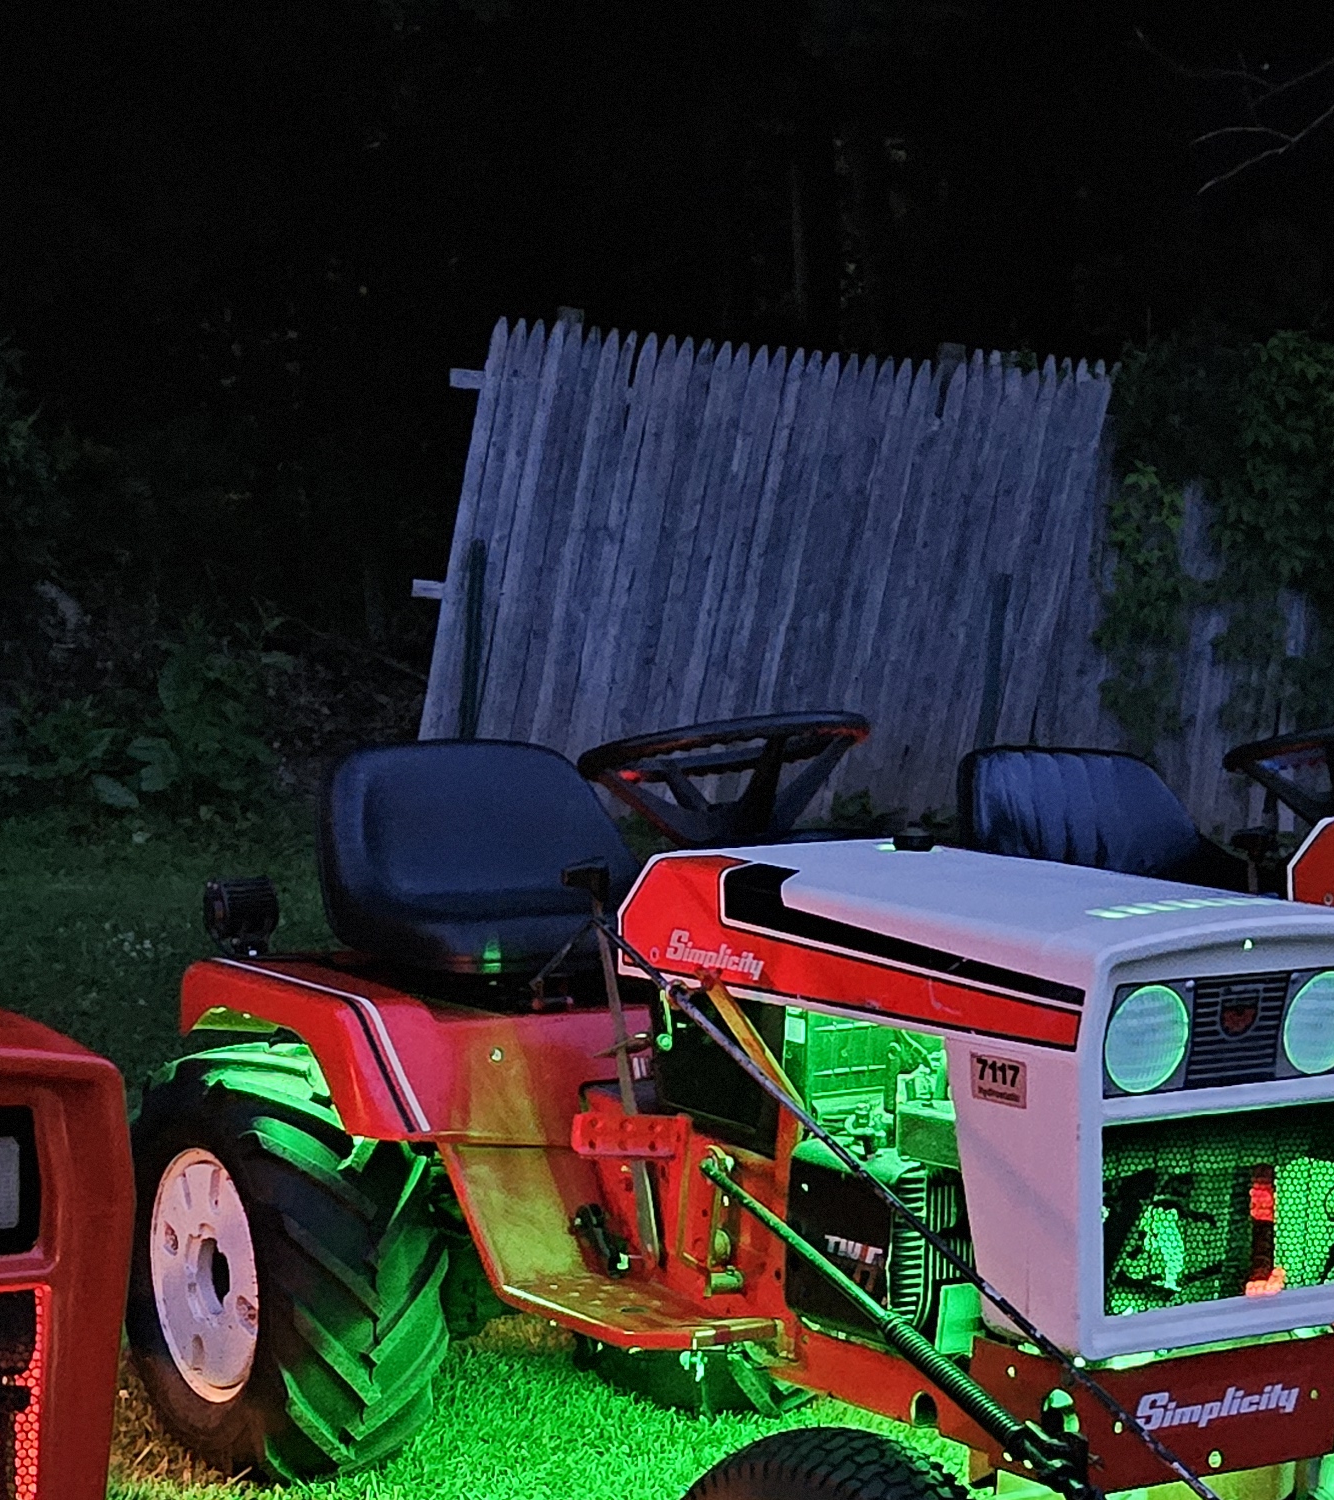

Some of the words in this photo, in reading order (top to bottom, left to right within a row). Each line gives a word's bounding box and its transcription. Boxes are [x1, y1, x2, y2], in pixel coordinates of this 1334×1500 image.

[665, 928, 765, 981] Simplicity
[976, 1057, 1020, 1088] 7117
[1135, 1383, 1300, 1431] Simplicity
